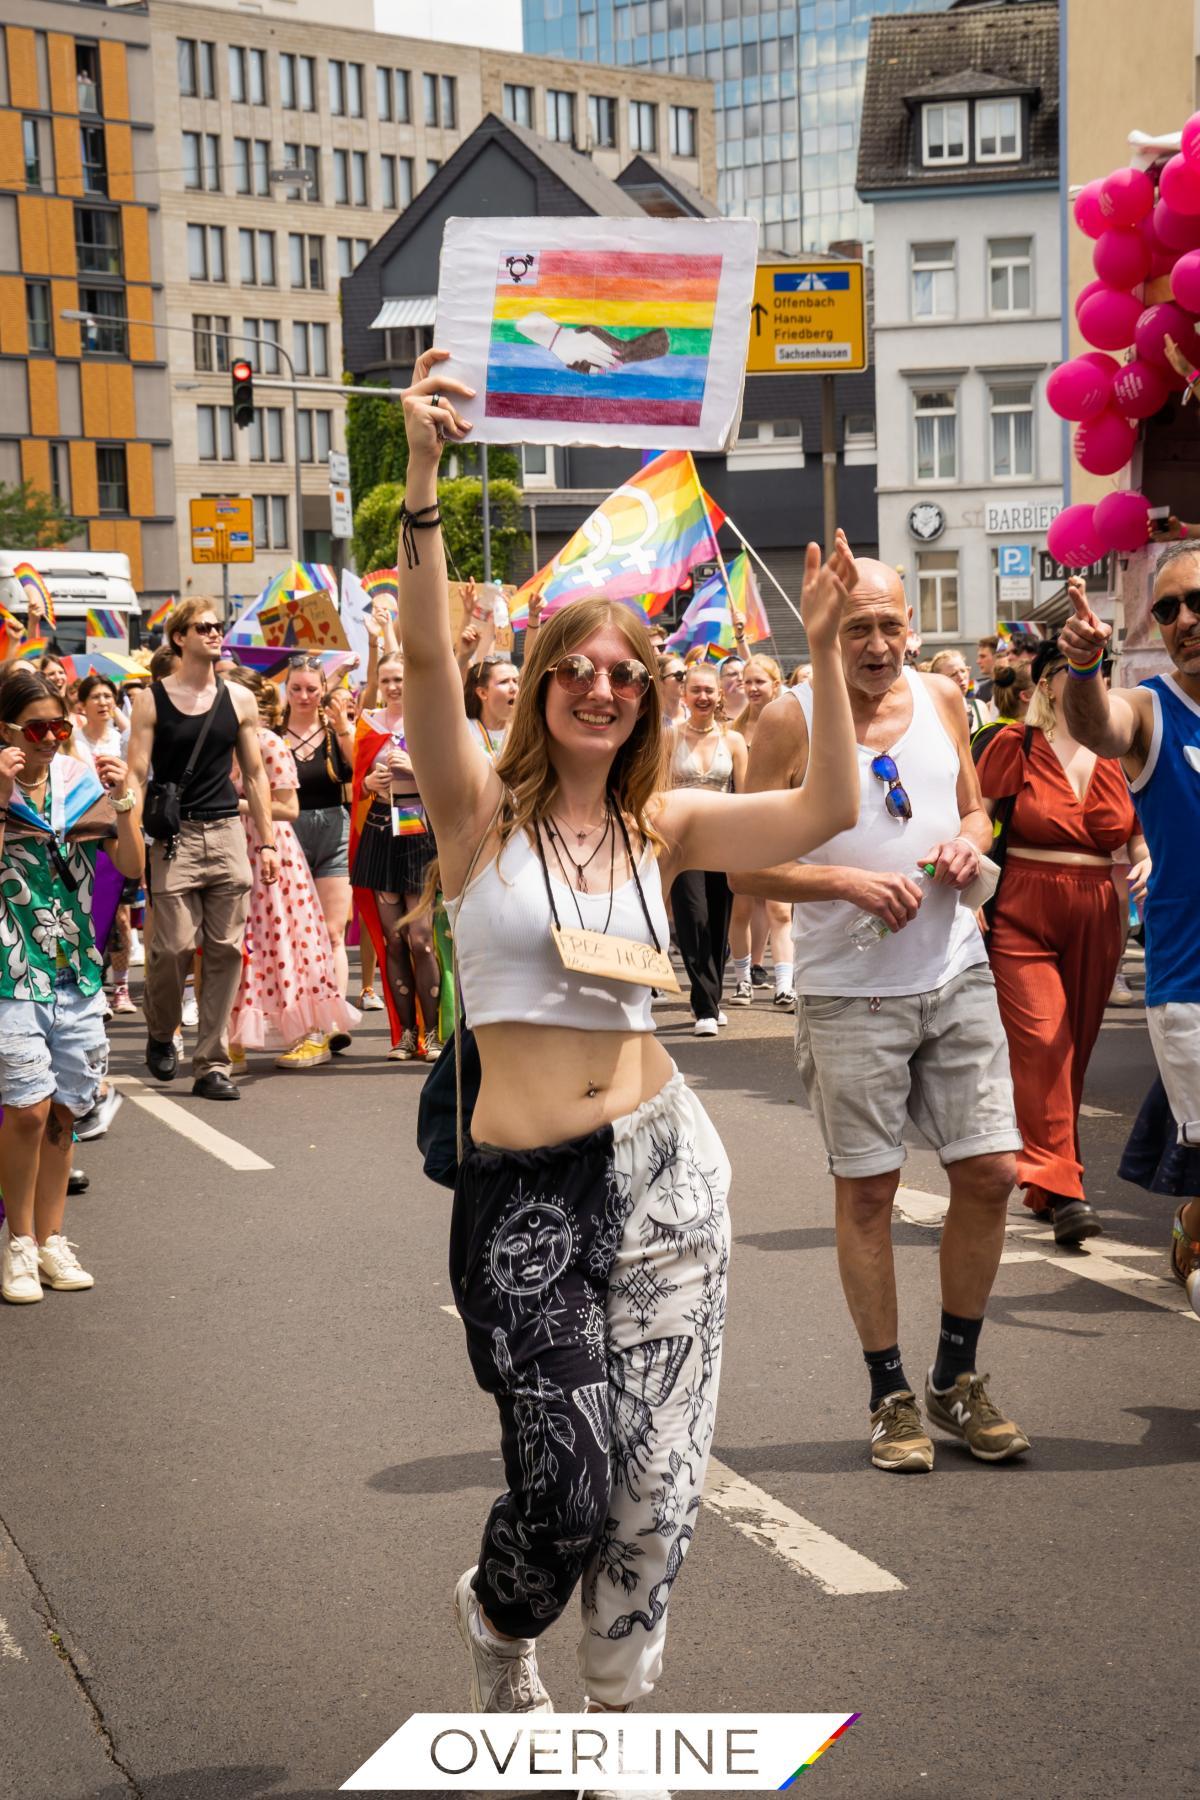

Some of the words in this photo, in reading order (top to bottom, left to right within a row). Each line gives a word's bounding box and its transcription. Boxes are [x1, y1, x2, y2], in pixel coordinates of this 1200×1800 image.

[774, 297, 835, 308] Offenbach
[774, 313, 812, 323] Hanau
[774, 328, 833, 341] Friedberg
[779, 346, 848, 359] Sachsenhausen
[1004, 548, 1021, 573] P
